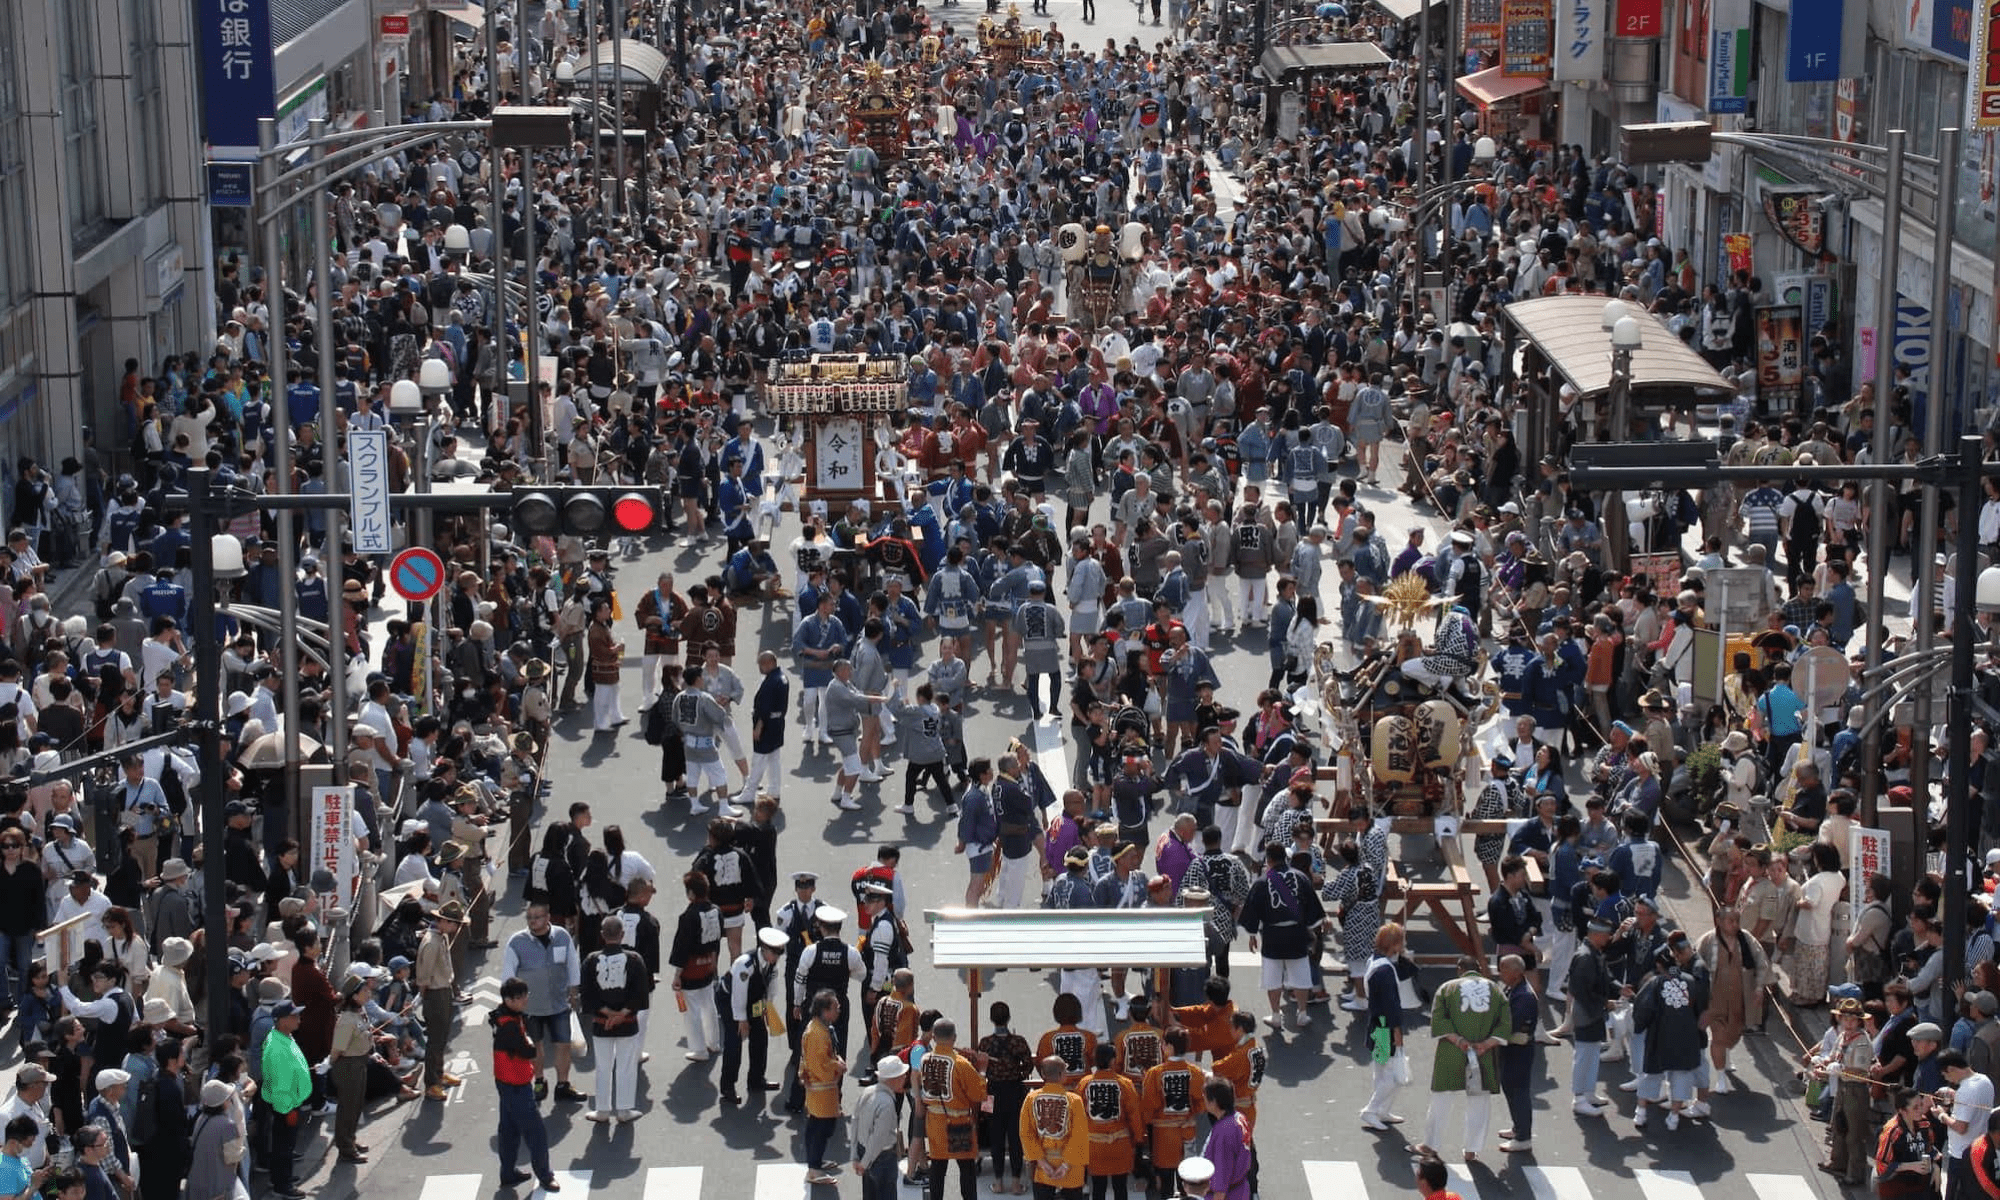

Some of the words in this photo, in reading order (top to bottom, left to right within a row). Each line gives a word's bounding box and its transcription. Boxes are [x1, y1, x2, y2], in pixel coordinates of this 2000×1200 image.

[1571, 0, 1592, 59] ラッグ
[1626, 15, 1650, 31] 2F
[1716, 30, 1733, 96] FamilyMart
[1804, 52, 1827, 69] 1F
[827, 433, 849, 480] 令和
[357, 437, 383, 549] スクランブル式
